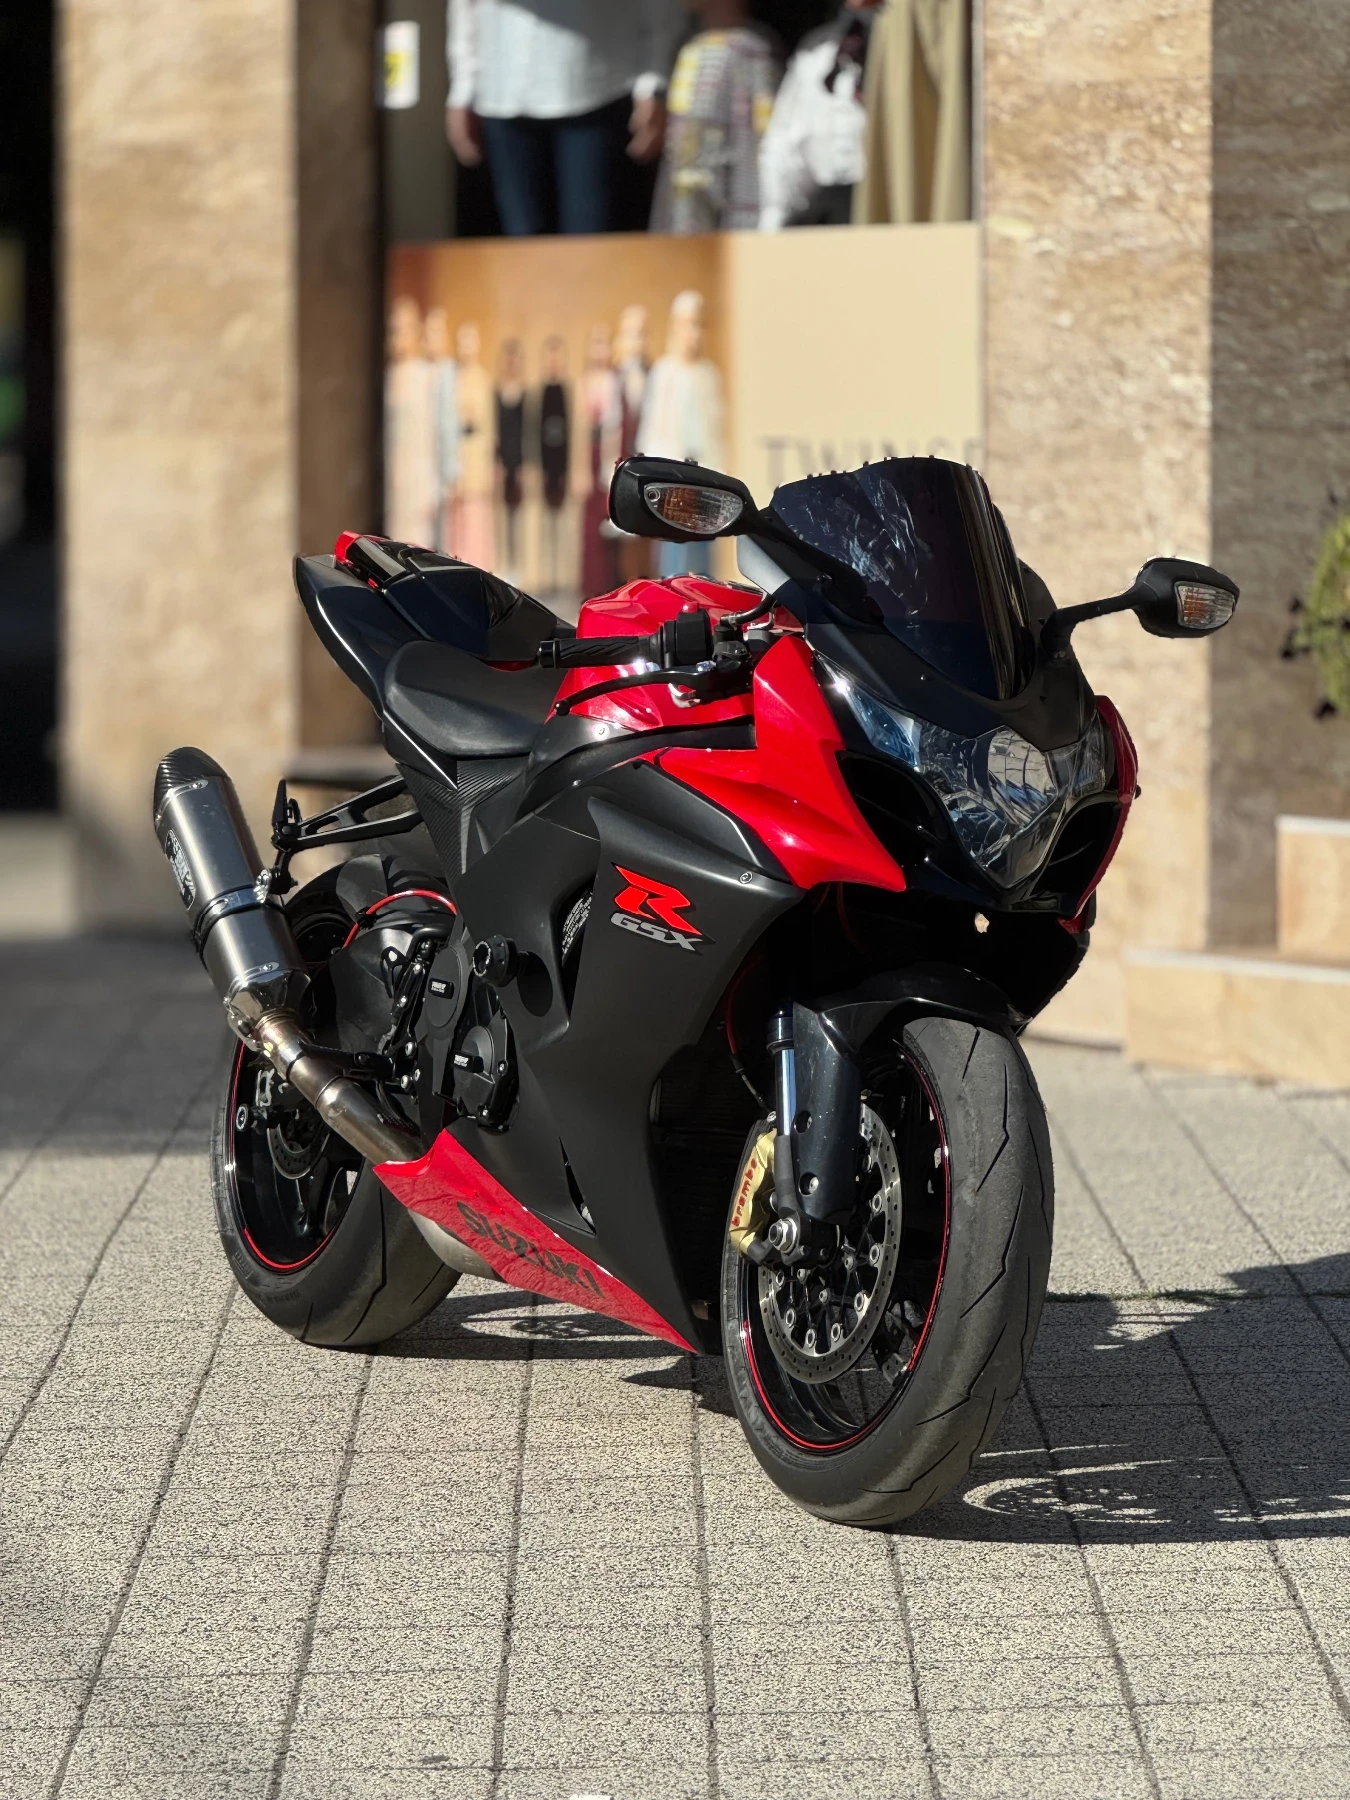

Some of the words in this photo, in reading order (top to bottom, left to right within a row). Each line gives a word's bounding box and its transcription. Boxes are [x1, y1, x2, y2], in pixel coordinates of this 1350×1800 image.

[610, 912, 703, 951] GSX
[612, 863, 704, 936] R
[731, 1158, 758, 1227] brembo
[456, 1200, 605, 1299] SUZUKI
